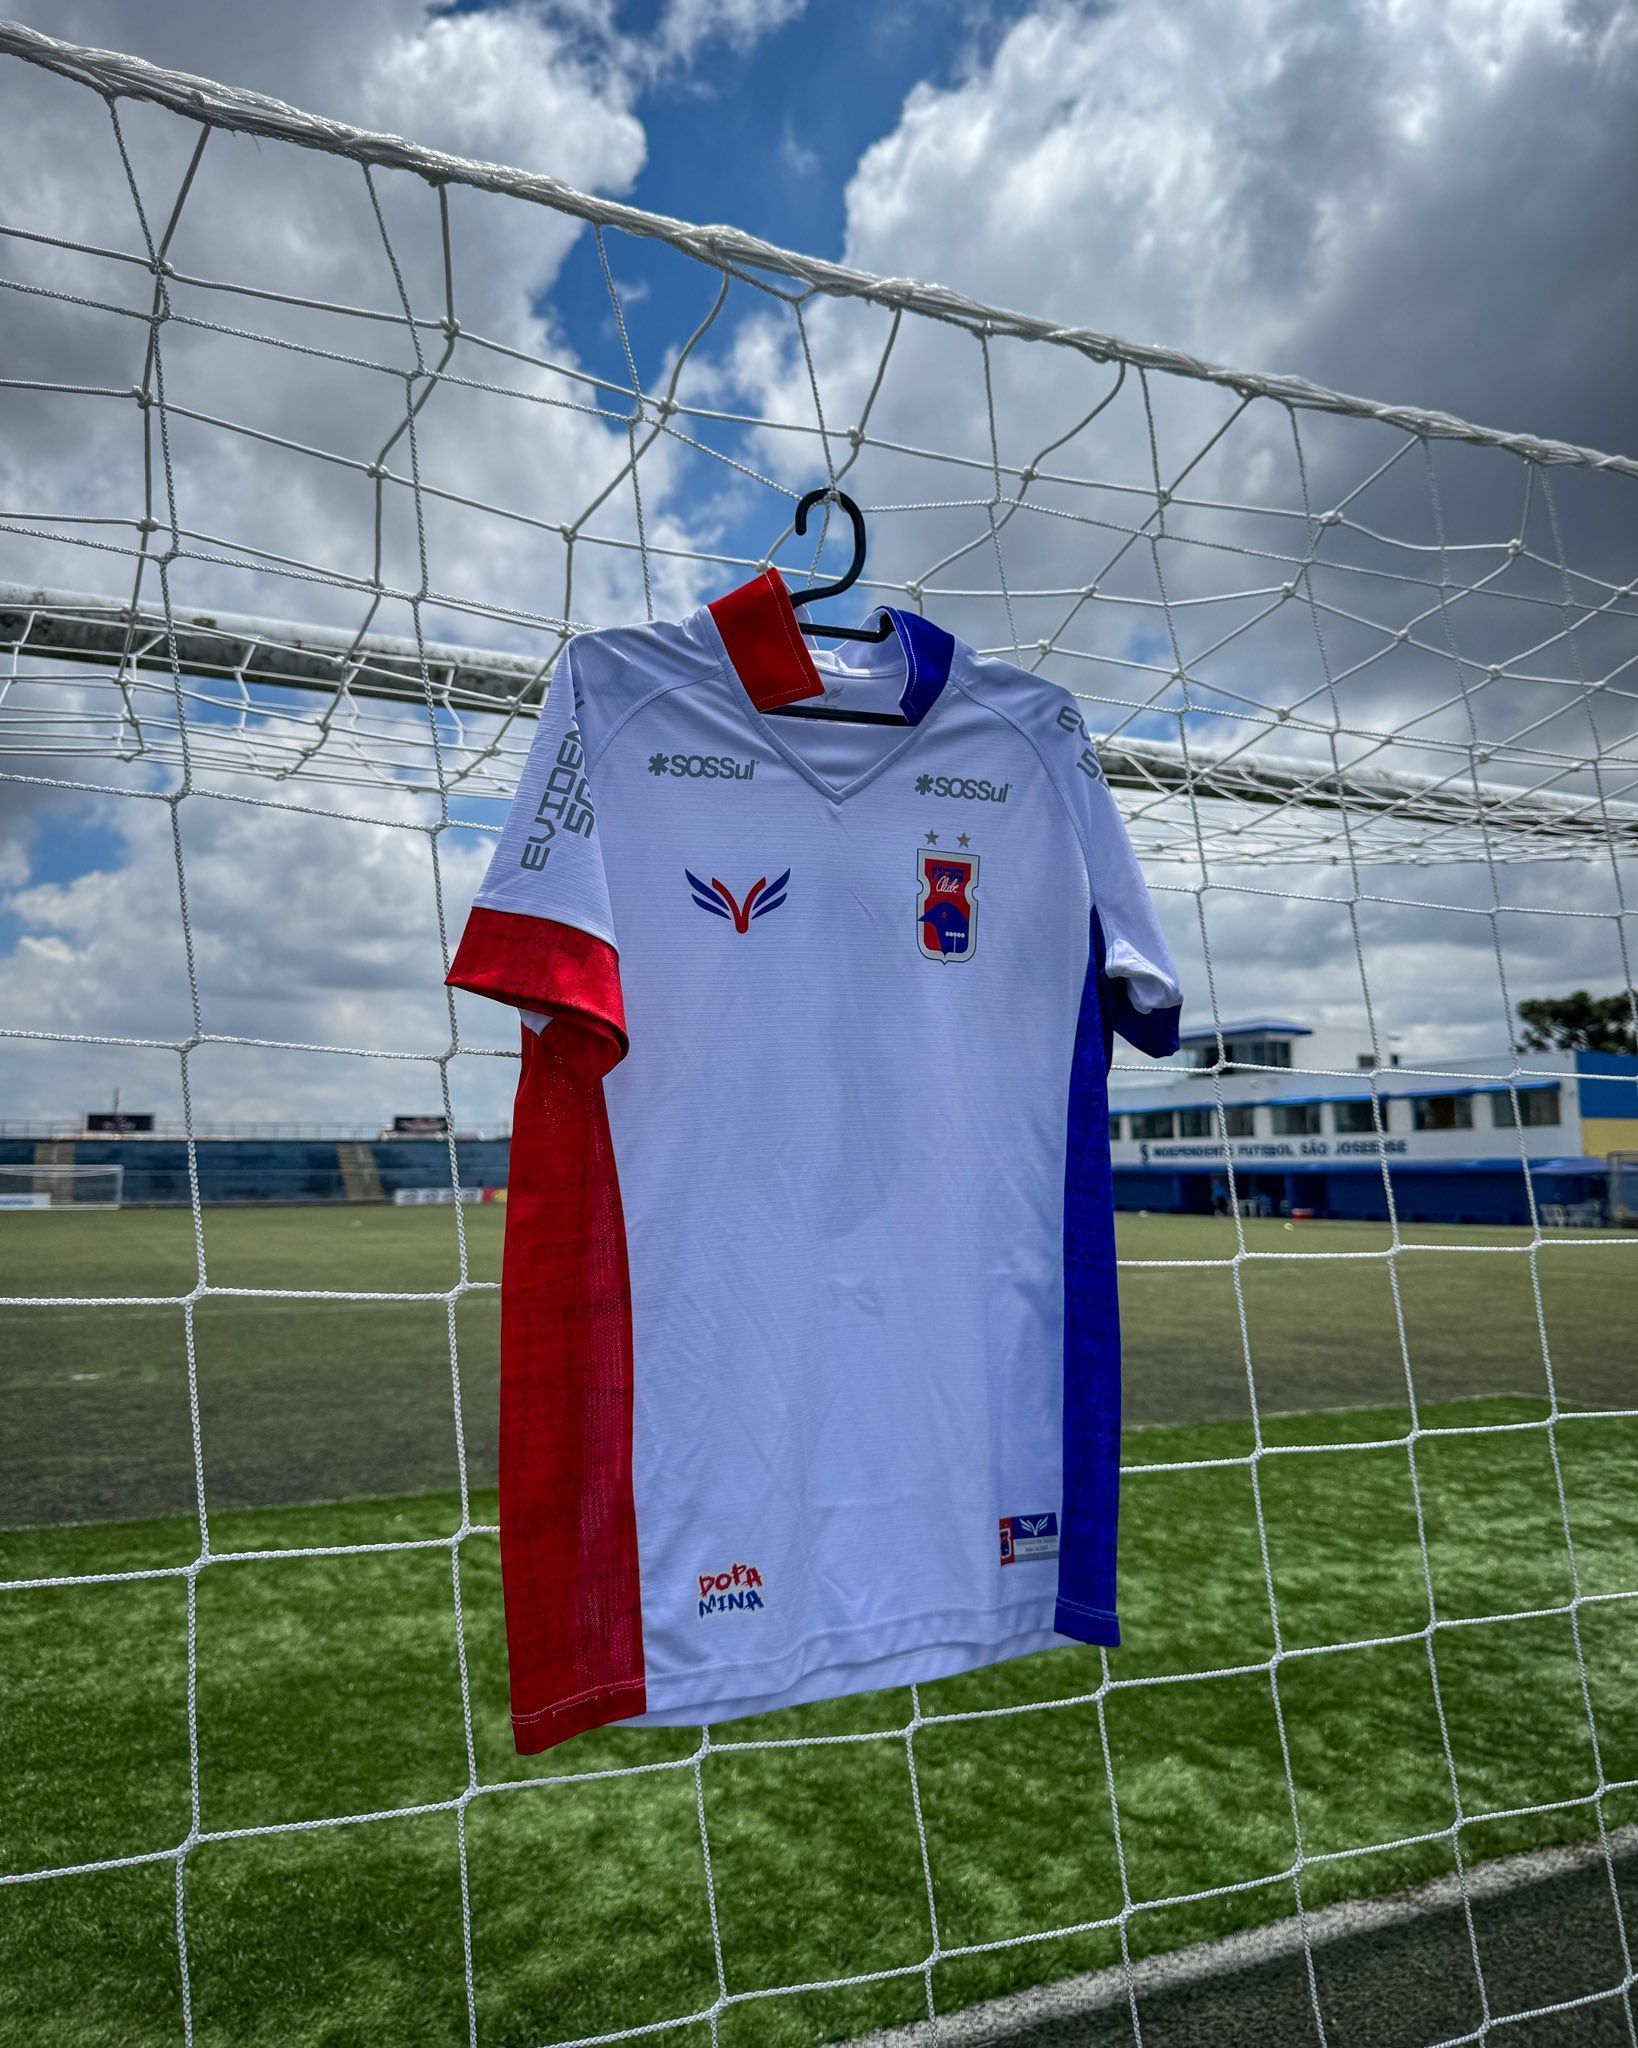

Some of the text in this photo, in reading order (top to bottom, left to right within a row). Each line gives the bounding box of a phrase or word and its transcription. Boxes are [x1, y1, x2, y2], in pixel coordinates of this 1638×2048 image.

[669, 754, 756, 780] SOSSul
[933, 776, 1009, 803] SOSSul
[698, 1589, 764, 1618] MINA
